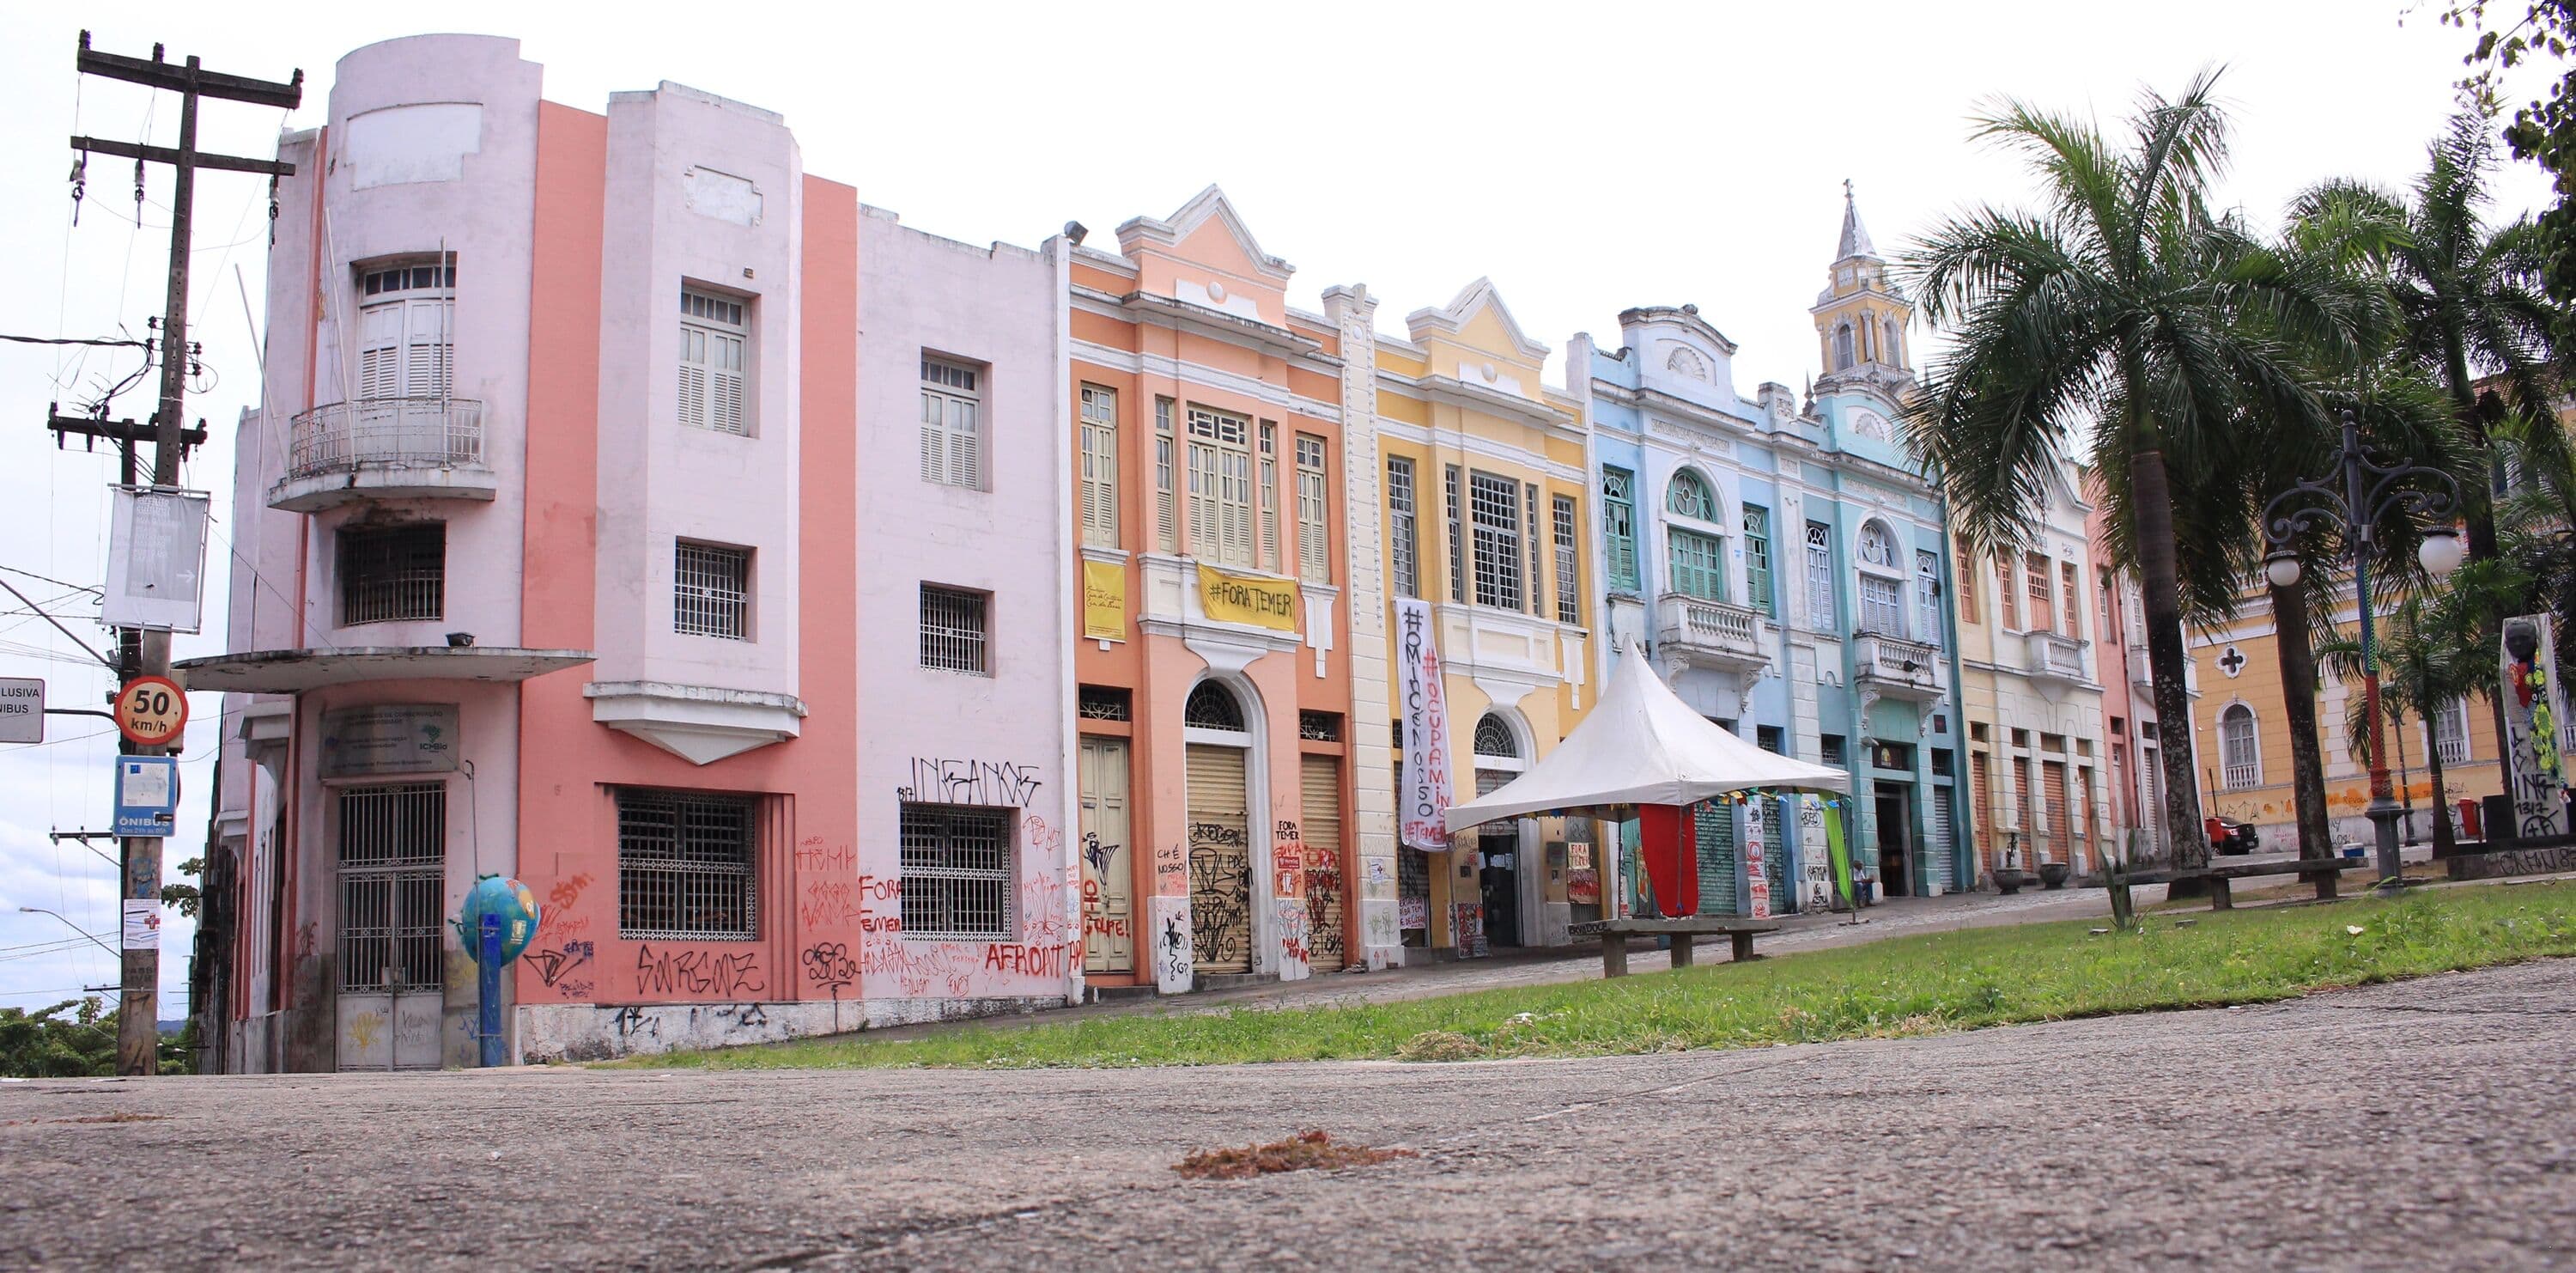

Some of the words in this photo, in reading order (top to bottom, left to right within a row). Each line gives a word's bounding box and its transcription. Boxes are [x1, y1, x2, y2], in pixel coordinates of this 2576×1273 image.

[1255, 588, 1292, 617] TEMER
[134, 690, 169, 716] 50
[131, 718, 167, 734] km/h
[1279, 820, 1297, 830] FORA
[1276, 831, 1299, 840] TEMER
[859, 875, 902, 900] FORA
